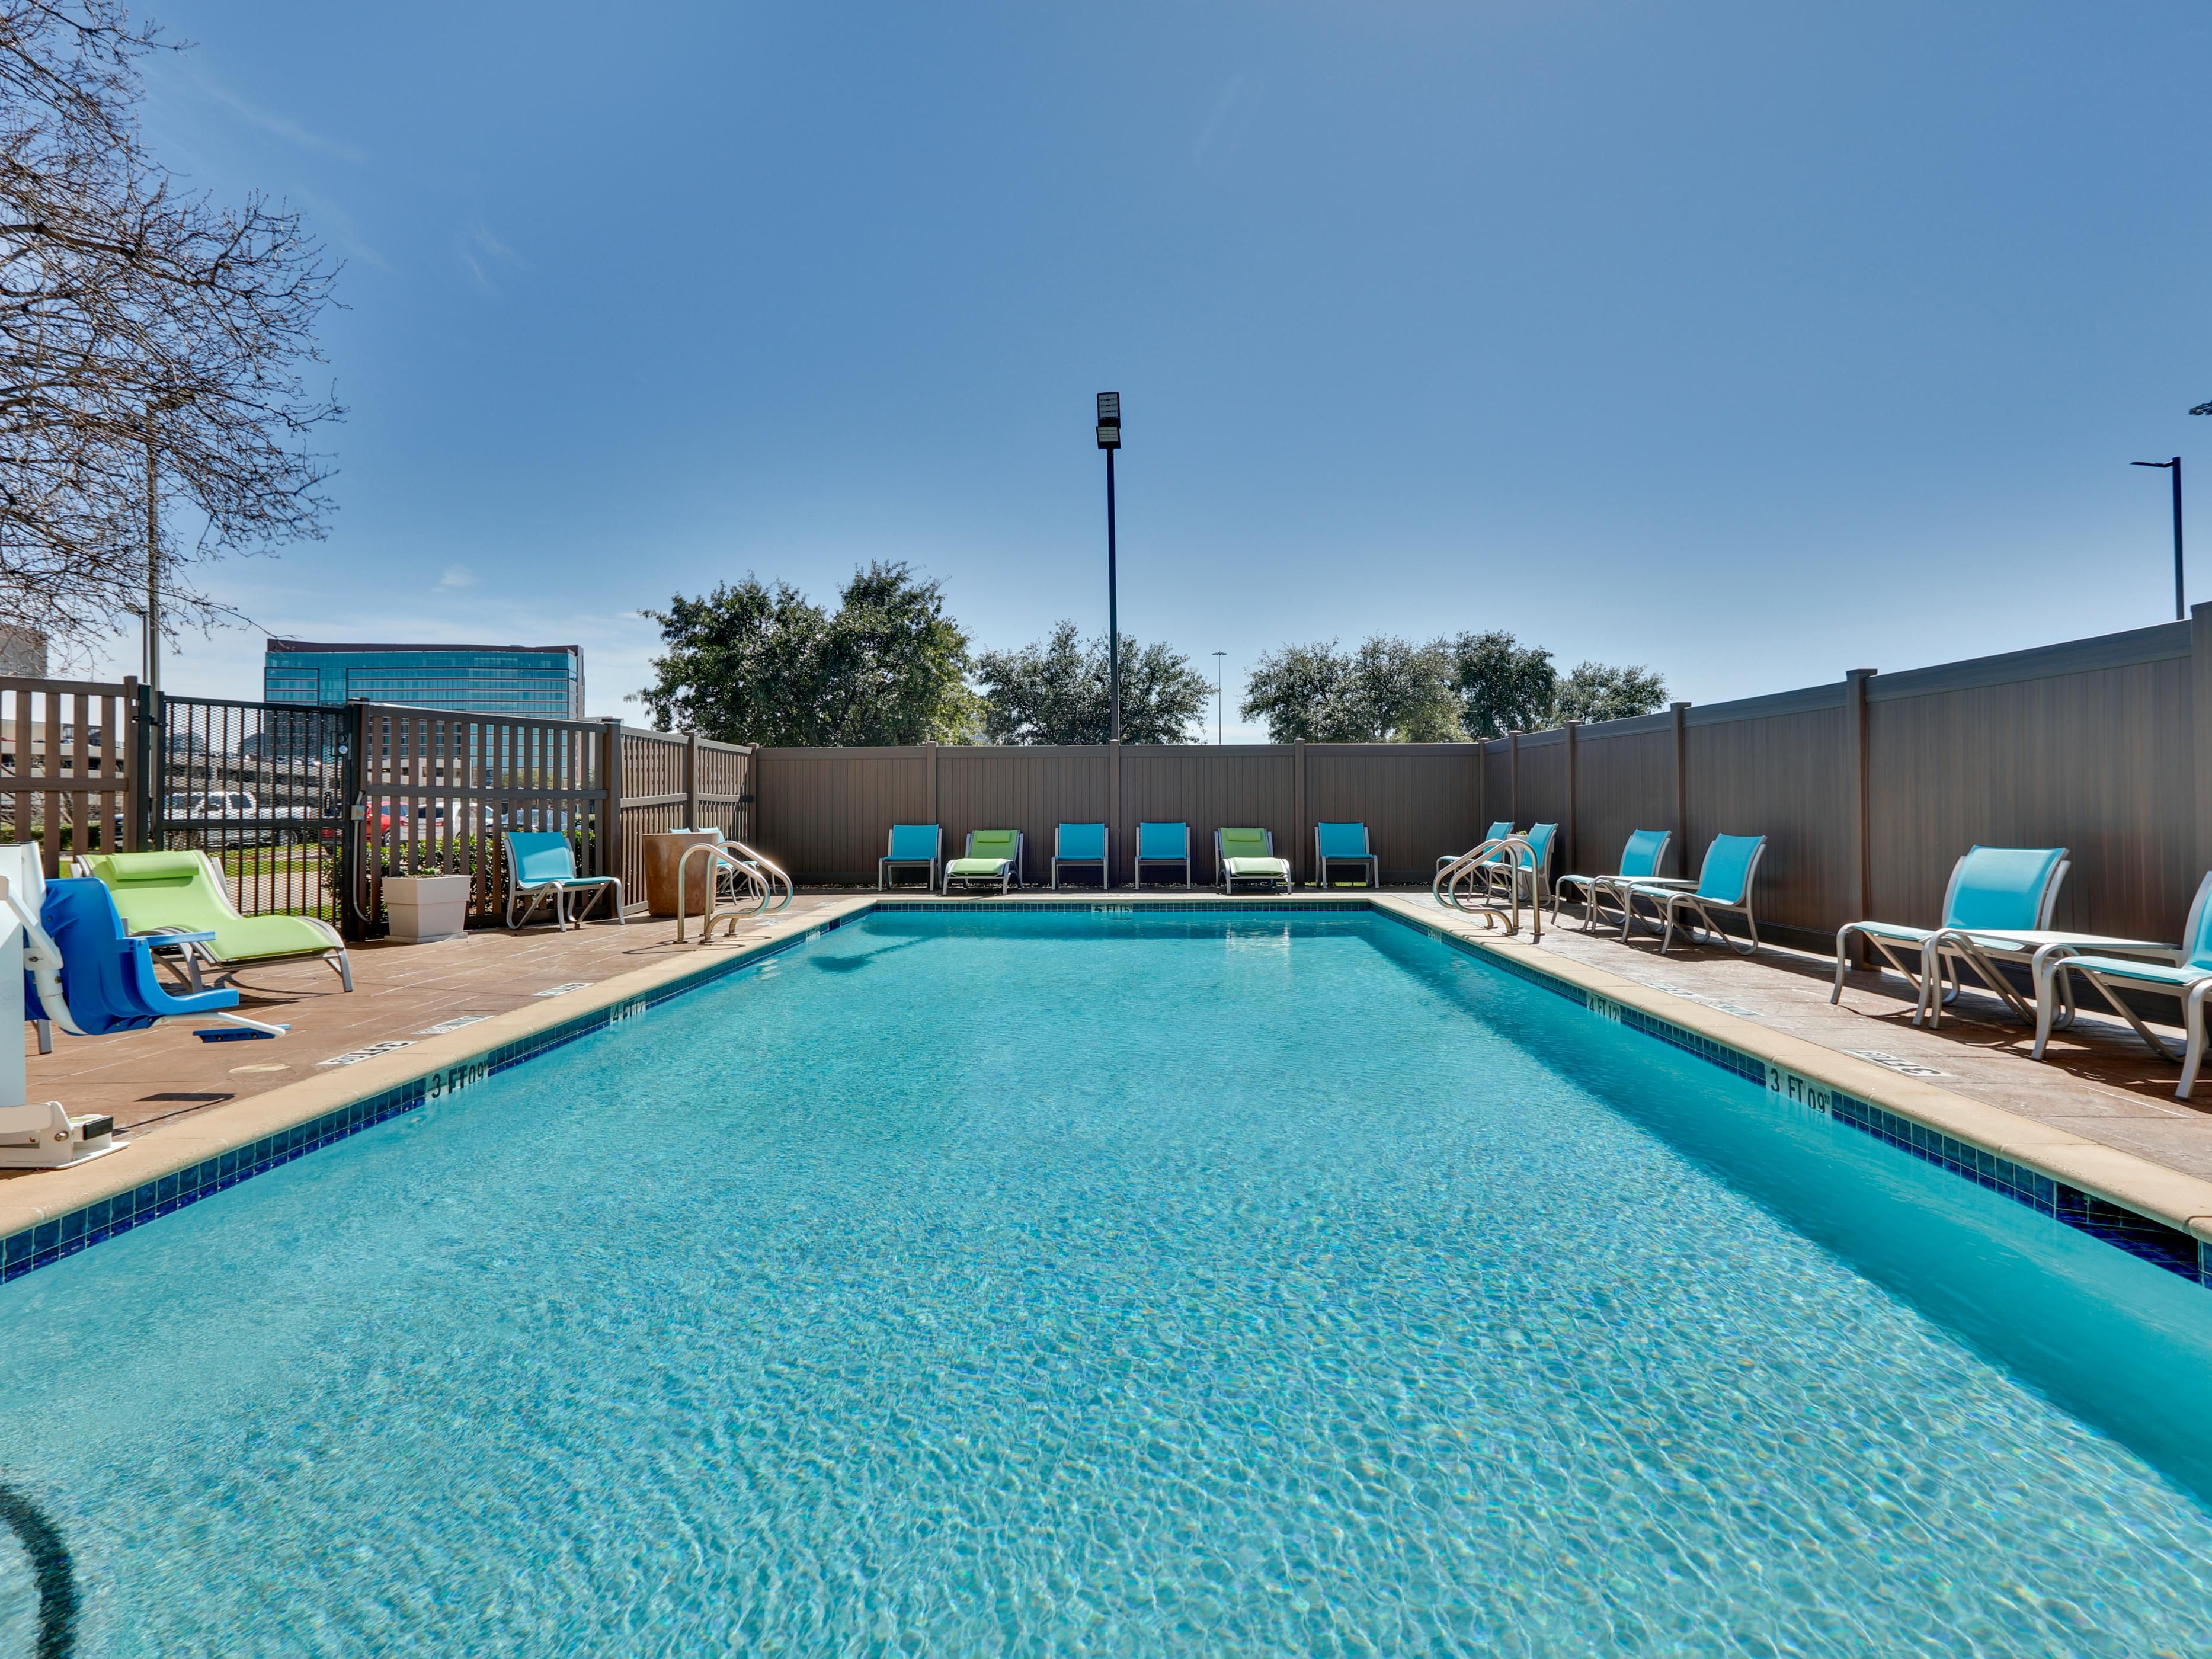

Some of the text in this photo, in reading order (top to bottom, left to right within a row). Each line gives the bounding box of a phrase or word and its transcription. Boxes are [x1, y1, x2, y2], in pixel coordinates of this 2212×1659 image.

[1589, 998, 1595, 1012] 4
[1598, 998, 1606, 1016] FT
[431, 1073, 441, 1098] 3
[449, 1064, 467, 1094] FT
[1771, 1068, 1780, 1093] 3
[1788, 1075, 1803, 1103] FT
